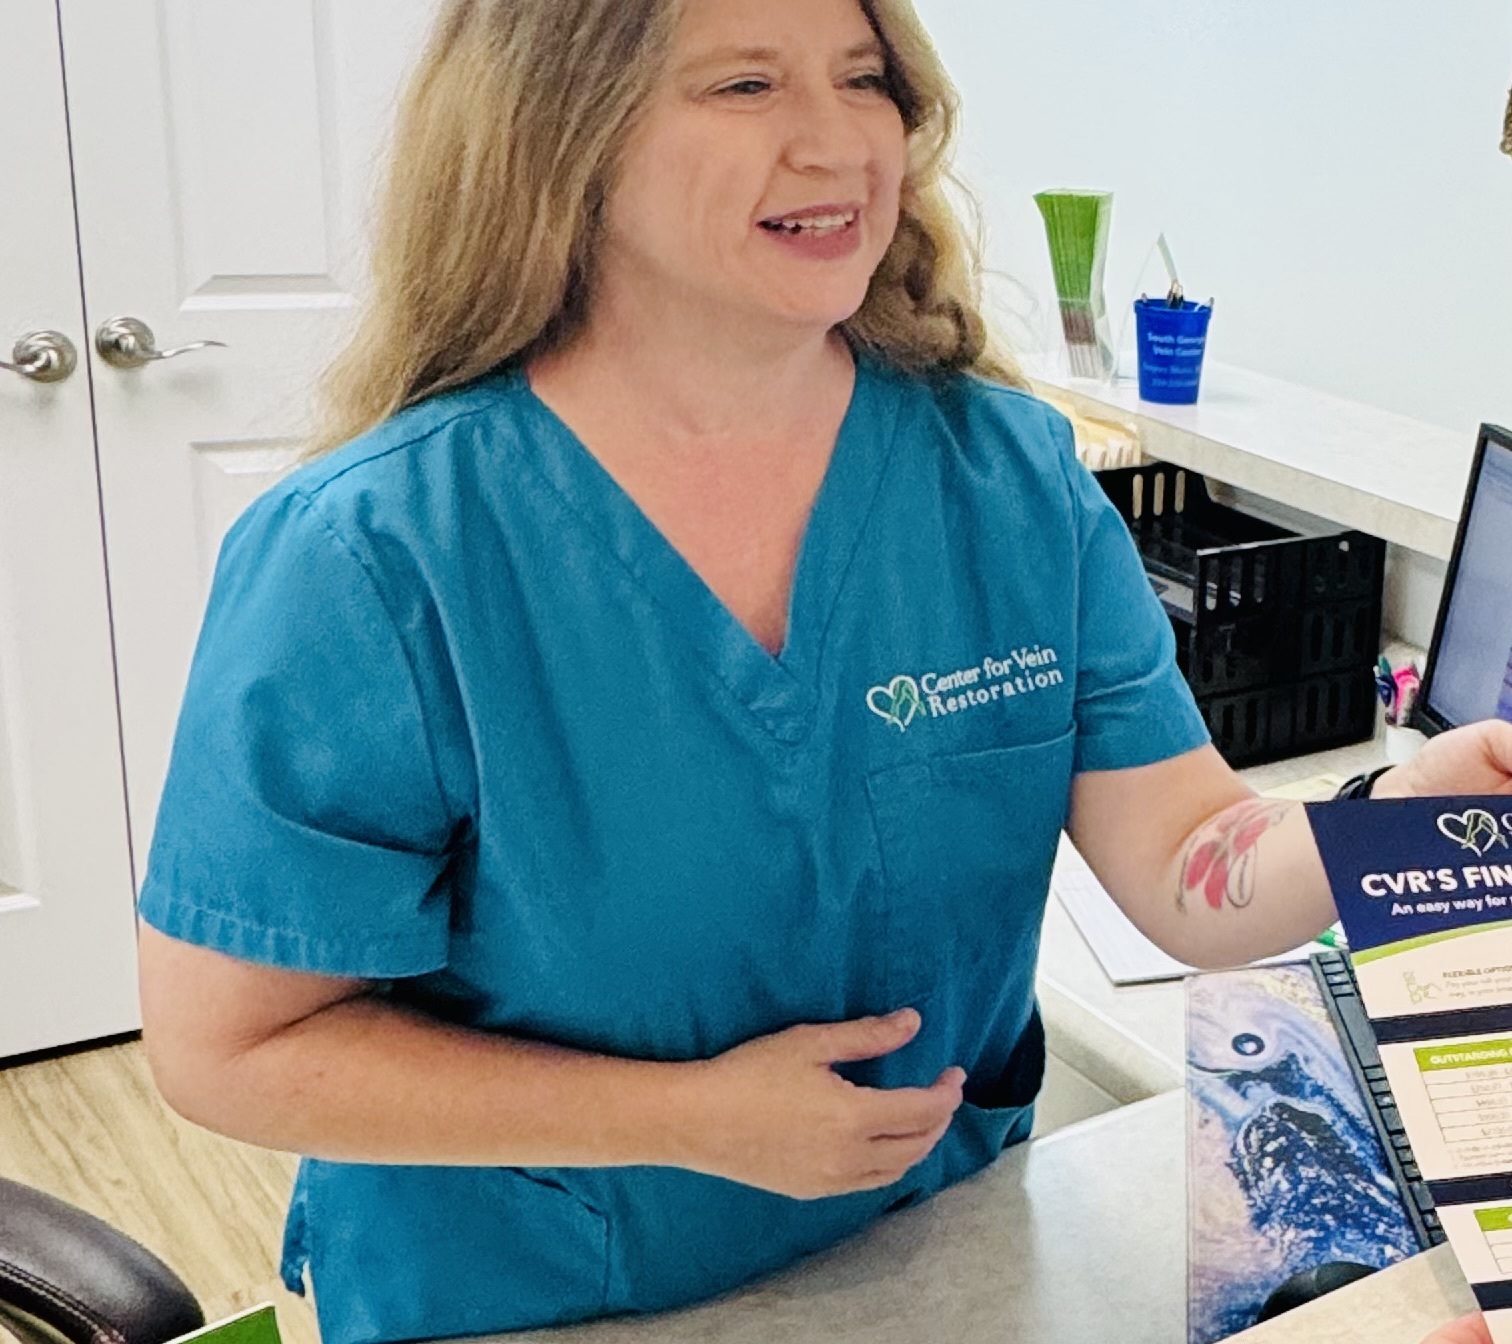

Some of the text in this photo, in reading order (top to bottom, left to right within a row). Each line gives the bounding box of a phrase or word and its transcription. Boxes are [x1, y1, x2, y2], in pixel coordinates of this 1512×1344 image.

[921, 644, 1058, 694] Center for Vein
[927, 667, 1064, 718] Restoration
[1361, 867, 1458, 898] CVR'S
[1391, 902, 1413, 916] An
[1416, 901, 1450, 914] easy
[1452, 896, 1484, 912] way
[1484, 894, 1508, 908] for
